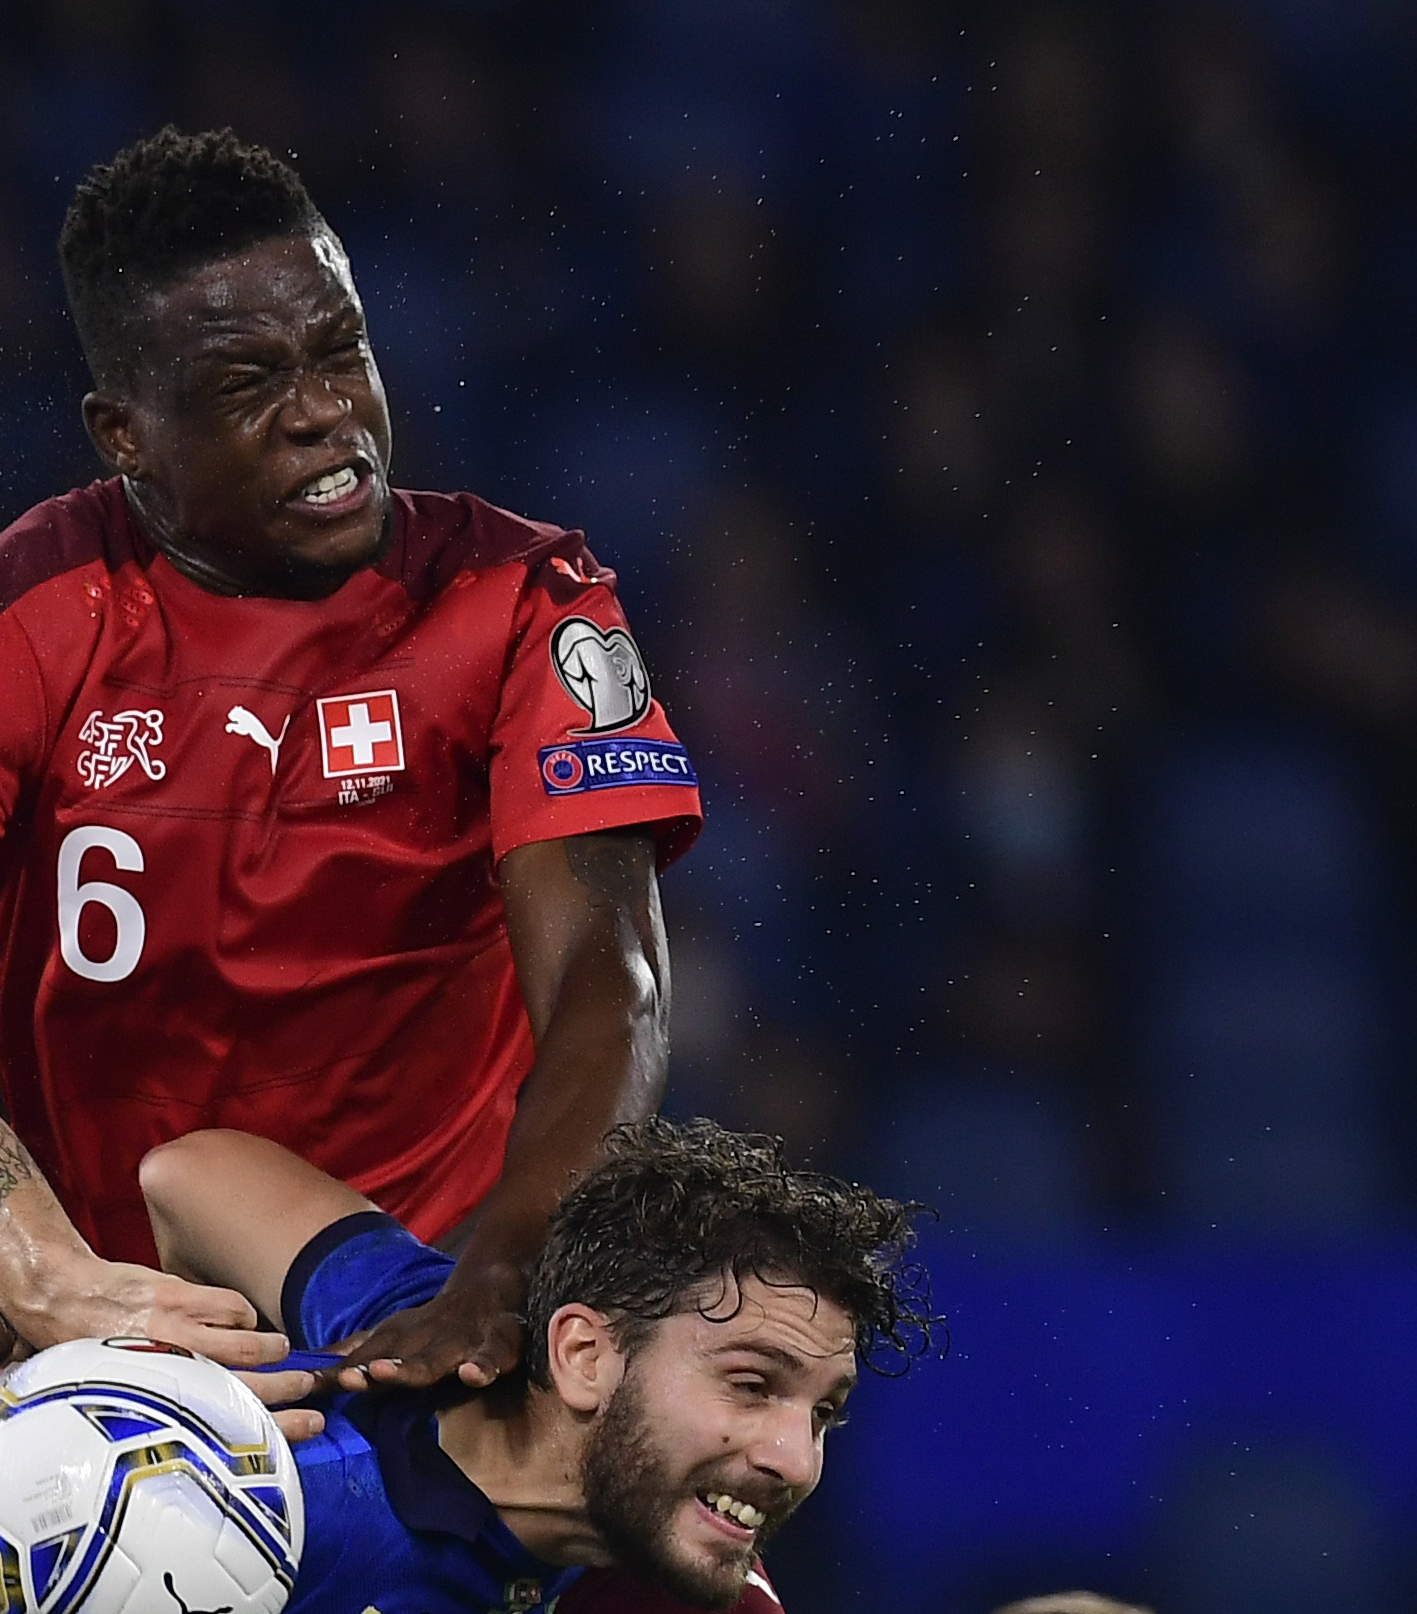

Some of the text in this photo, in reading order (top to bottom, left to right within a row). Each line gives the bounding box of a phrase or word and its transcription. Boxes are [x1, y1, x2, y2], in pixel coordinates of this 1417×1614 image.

[586, 751, 688, 776] RESPECT
[338, 790, 359, 805] ITA
[57, 825, 146, 982] 6
